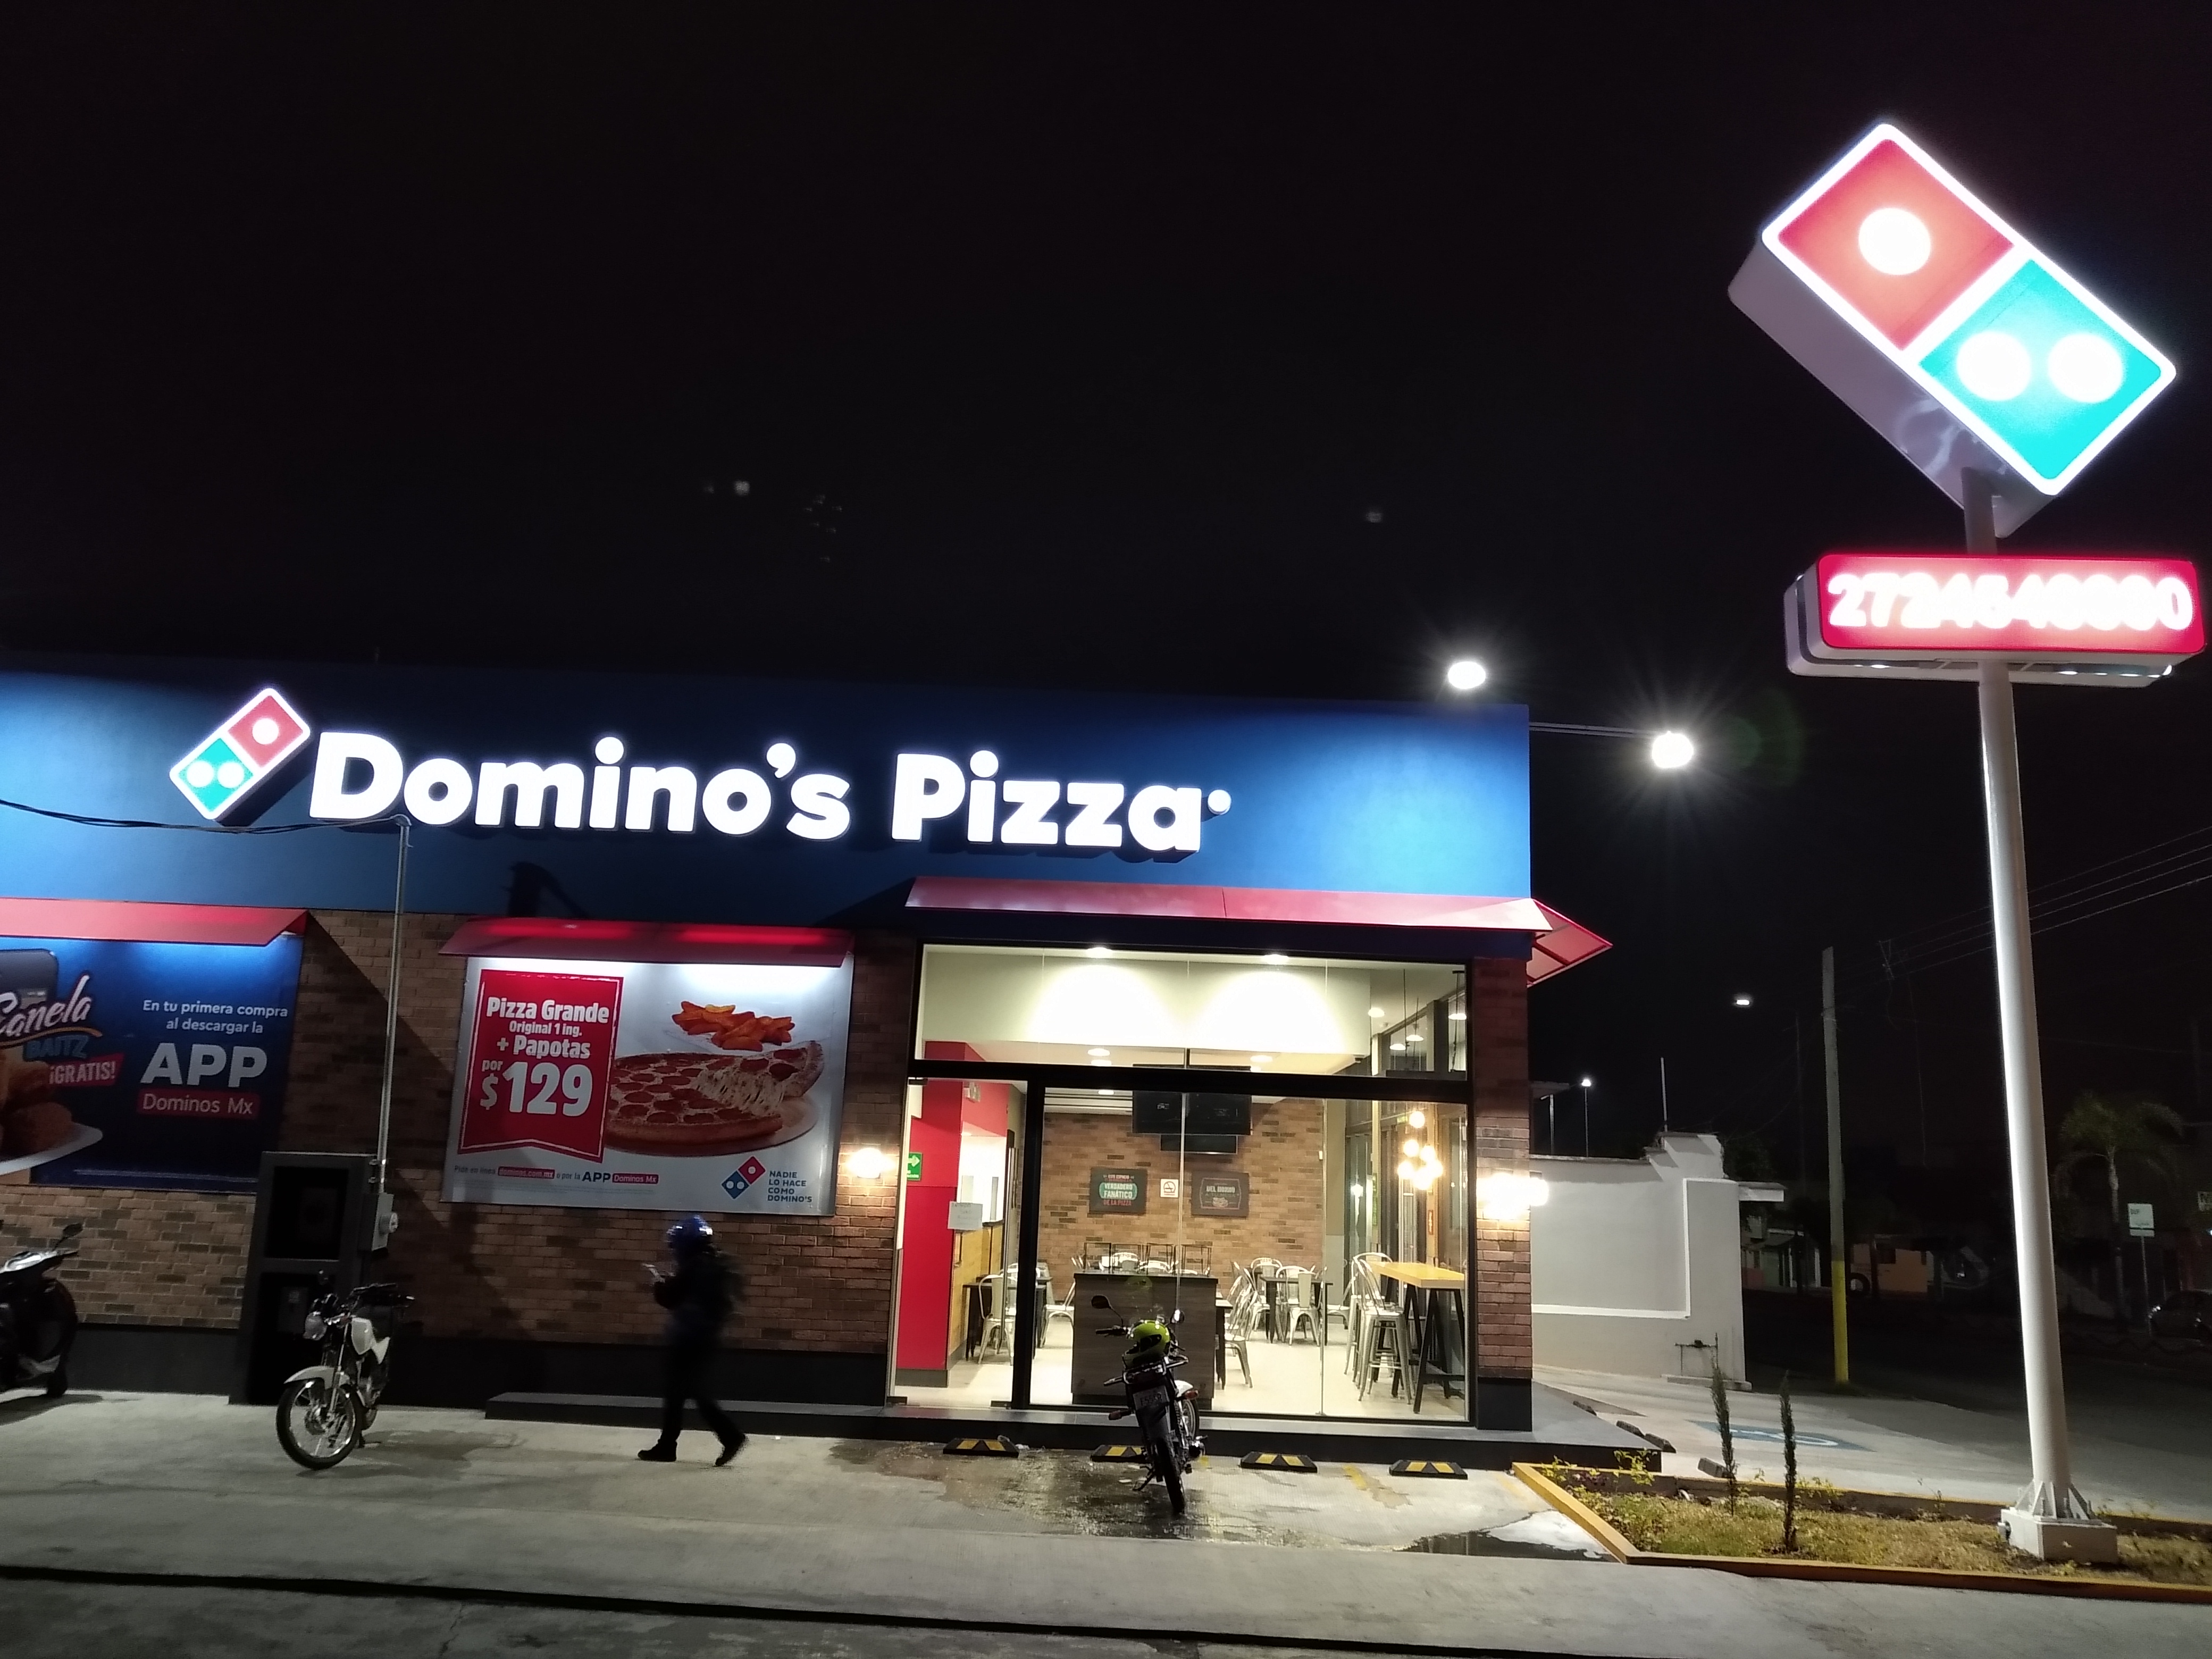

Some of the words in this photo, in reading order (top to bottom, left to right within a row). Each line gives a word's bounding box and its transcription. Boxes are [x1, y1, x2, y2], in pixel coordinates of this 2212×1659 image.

[309, 732, 851, 841] Domino's
[892, 750, 1202, 851] Pizza
[143, 1000, 159, 1011] En
[163, 1001, 177, 1012] tu
[181, 1000, 233, 1015] primera
[237, 1006, 288, 1019] compra
[486, 996, 537, 1019] Pizza
[541, 1000, 609, 1024] Grande
[166, 1017, 179, 1030] al
[181, 1018, 249, 1035] descargar
[252, 1021, 263, 1034] la
[509, 1020, 551, 1035] Original
[554, 1023, 560, 1035] 1
[562, 1023, 583, 1037] ing.
[497, 1037, 509, 1051] +
[513, 1034, 590, 1059] Papotas
[49, 1061, 116, 1085] ¡GRATIS!
[140, 1042, 267, 1088] APP
[482, 1060, 503, 1072] por
[502, 1061, 593, 1117] 129
[143, 1093, 221, 1113] Dominos
[228, 1097, 253, 1114] Mx
[582, 1171, 611, 1183] APP
[614, 1174, 644, 1183] Dominos
